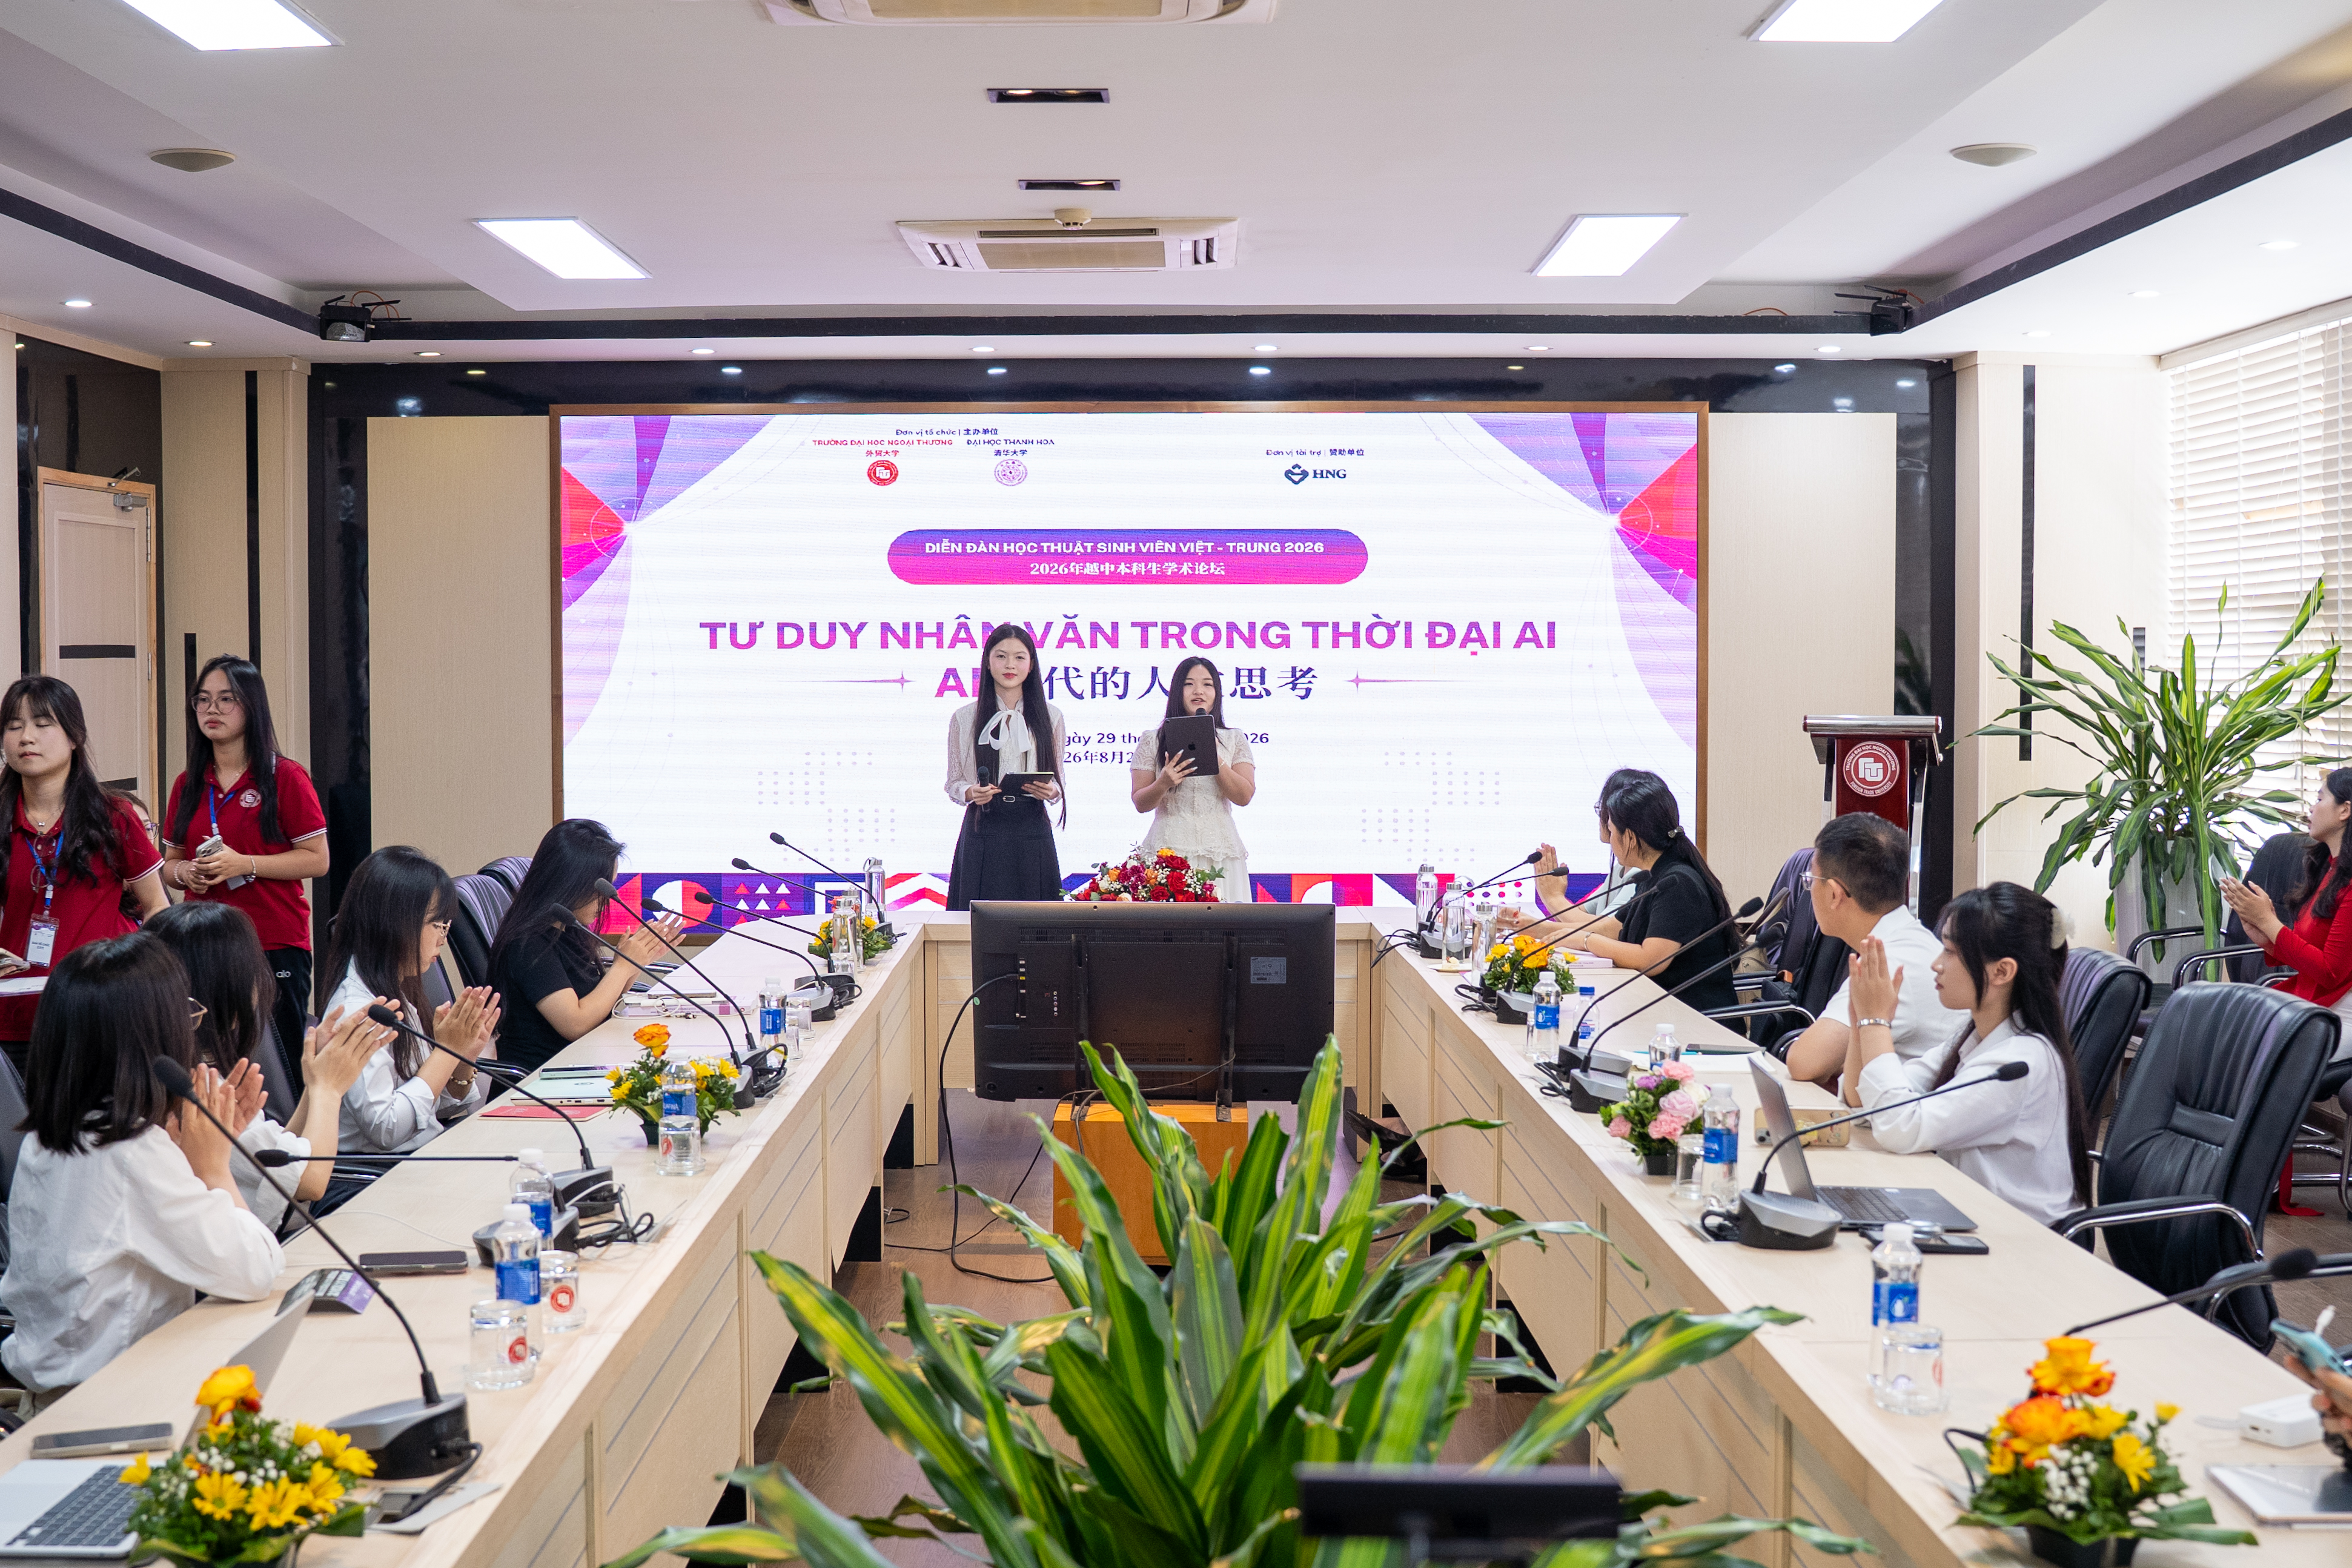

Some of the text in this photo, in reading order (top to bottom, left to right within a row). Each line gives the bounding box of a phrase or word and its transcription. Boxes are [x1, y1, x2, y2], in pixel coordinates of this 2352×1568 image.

[1312, 469, 1347, 479] HNG
[925, 538, 962, 553] DIỄN
[966, 540, 999, 553] ĐÀN
[1003, 542, 1038, 555] HỌC
[1040, 540, 1094, 555] THUẬT
[1096, 542, 1136, 553] SINH
[1139, 540, 1176, 553] VIÊN
[1179, 540, 1214, 555] VIỆT
[1226, 542, 1281, 553] TRUNG
[1284, 541, 1324, 553] 2026
[1030, 561, 1225, 575] 2026年越中本科生学术论坛
[700, 621, 764, 650] TƯ
[777, 621, 869, 649] DUY
[1023, 613, 1119, 649] VĂN
[1130, 621, 1291, 649] TRONG
[1302, 613, 1413, 649] THỜI
[1425, 621, 1500, 656] ĐẠI
[1514, 621, 1555, 649] AI
[935, 666, 1318, 700] AI代的人思考
[1065, 732, 1091, 747] gày
[1097, 732, 1116, 744] 29
